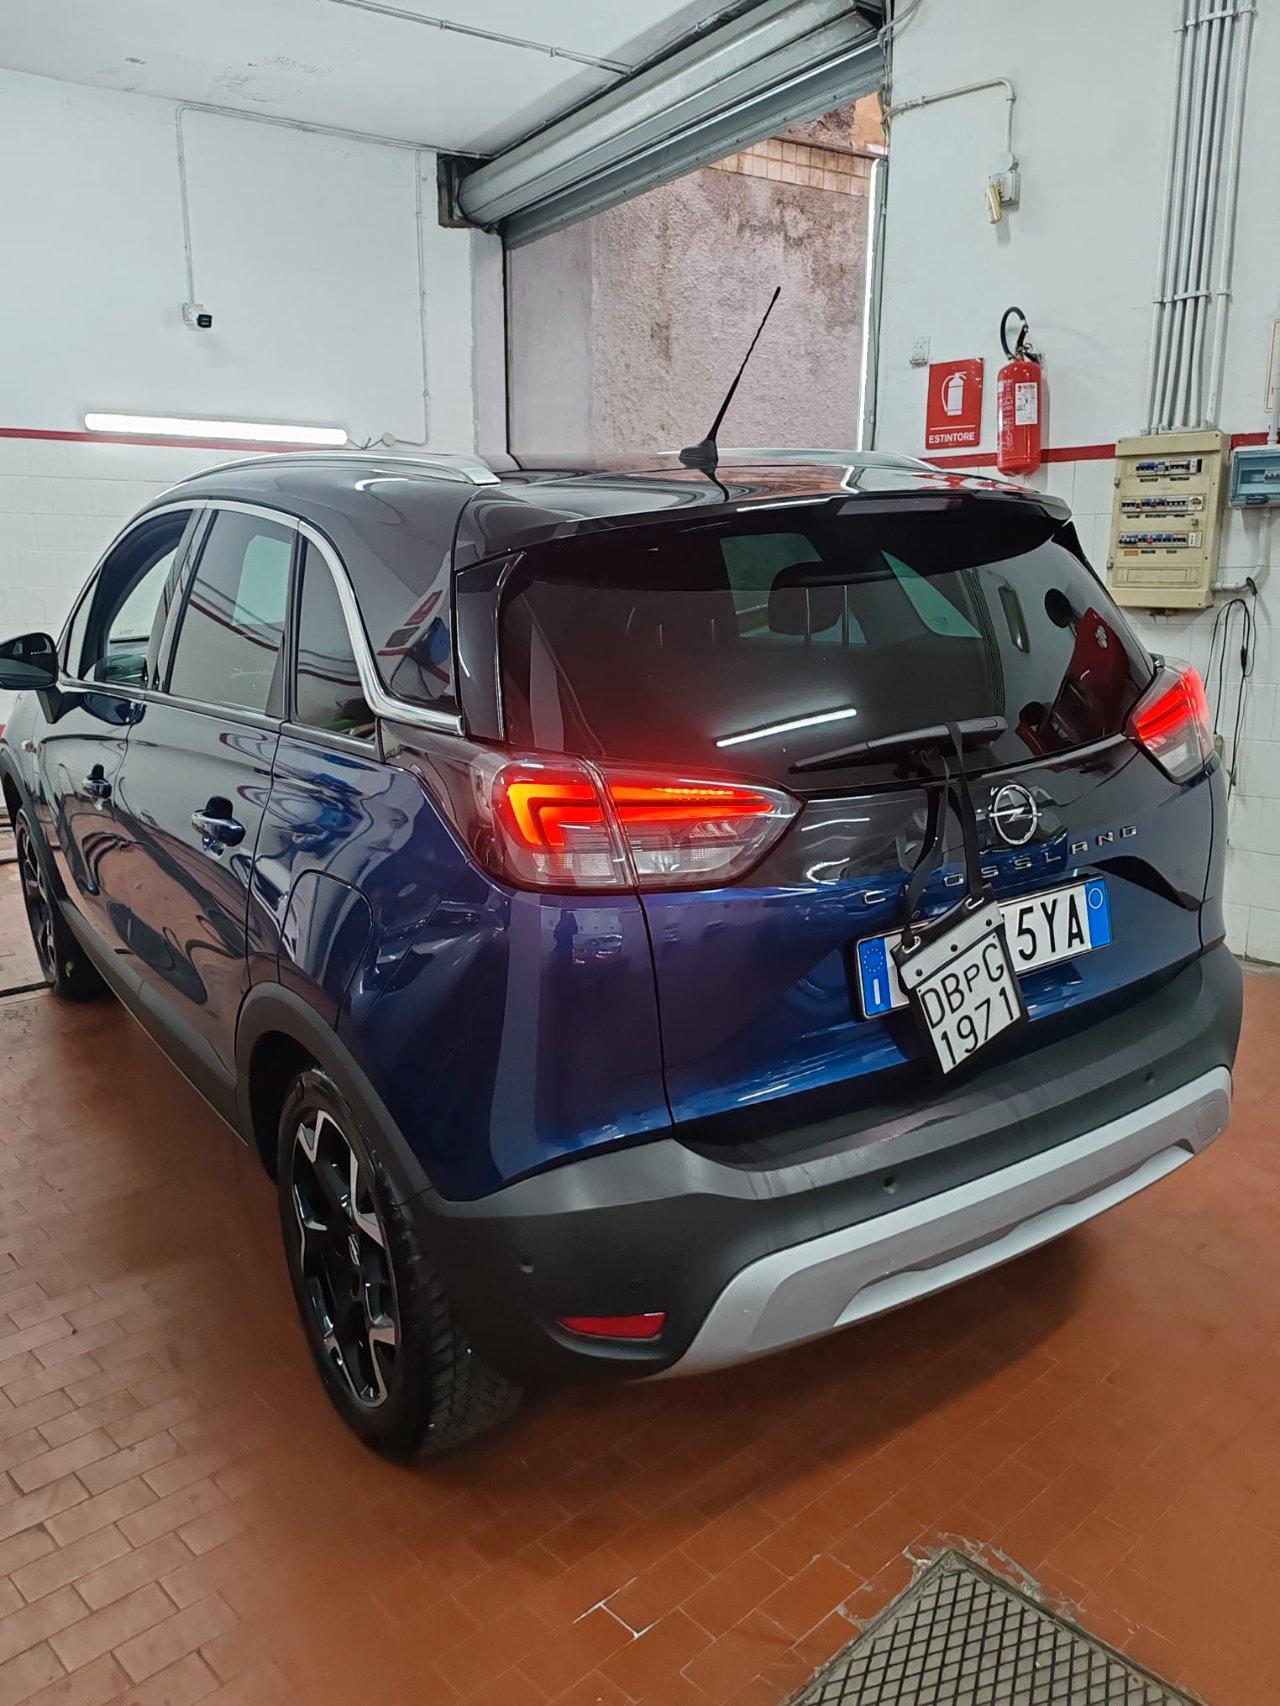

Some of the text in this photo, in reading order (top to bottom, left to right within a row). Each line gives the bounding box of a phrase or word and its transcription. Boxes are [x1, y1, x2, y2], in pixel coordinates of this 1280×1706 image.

[929, 432, 975, 444] ESTINTORE
[864, 825, 1137, 905] COSSLAND
[1001, 894, 1084, 961] 5YA
[941, 986, 1014, 1065] 1971
